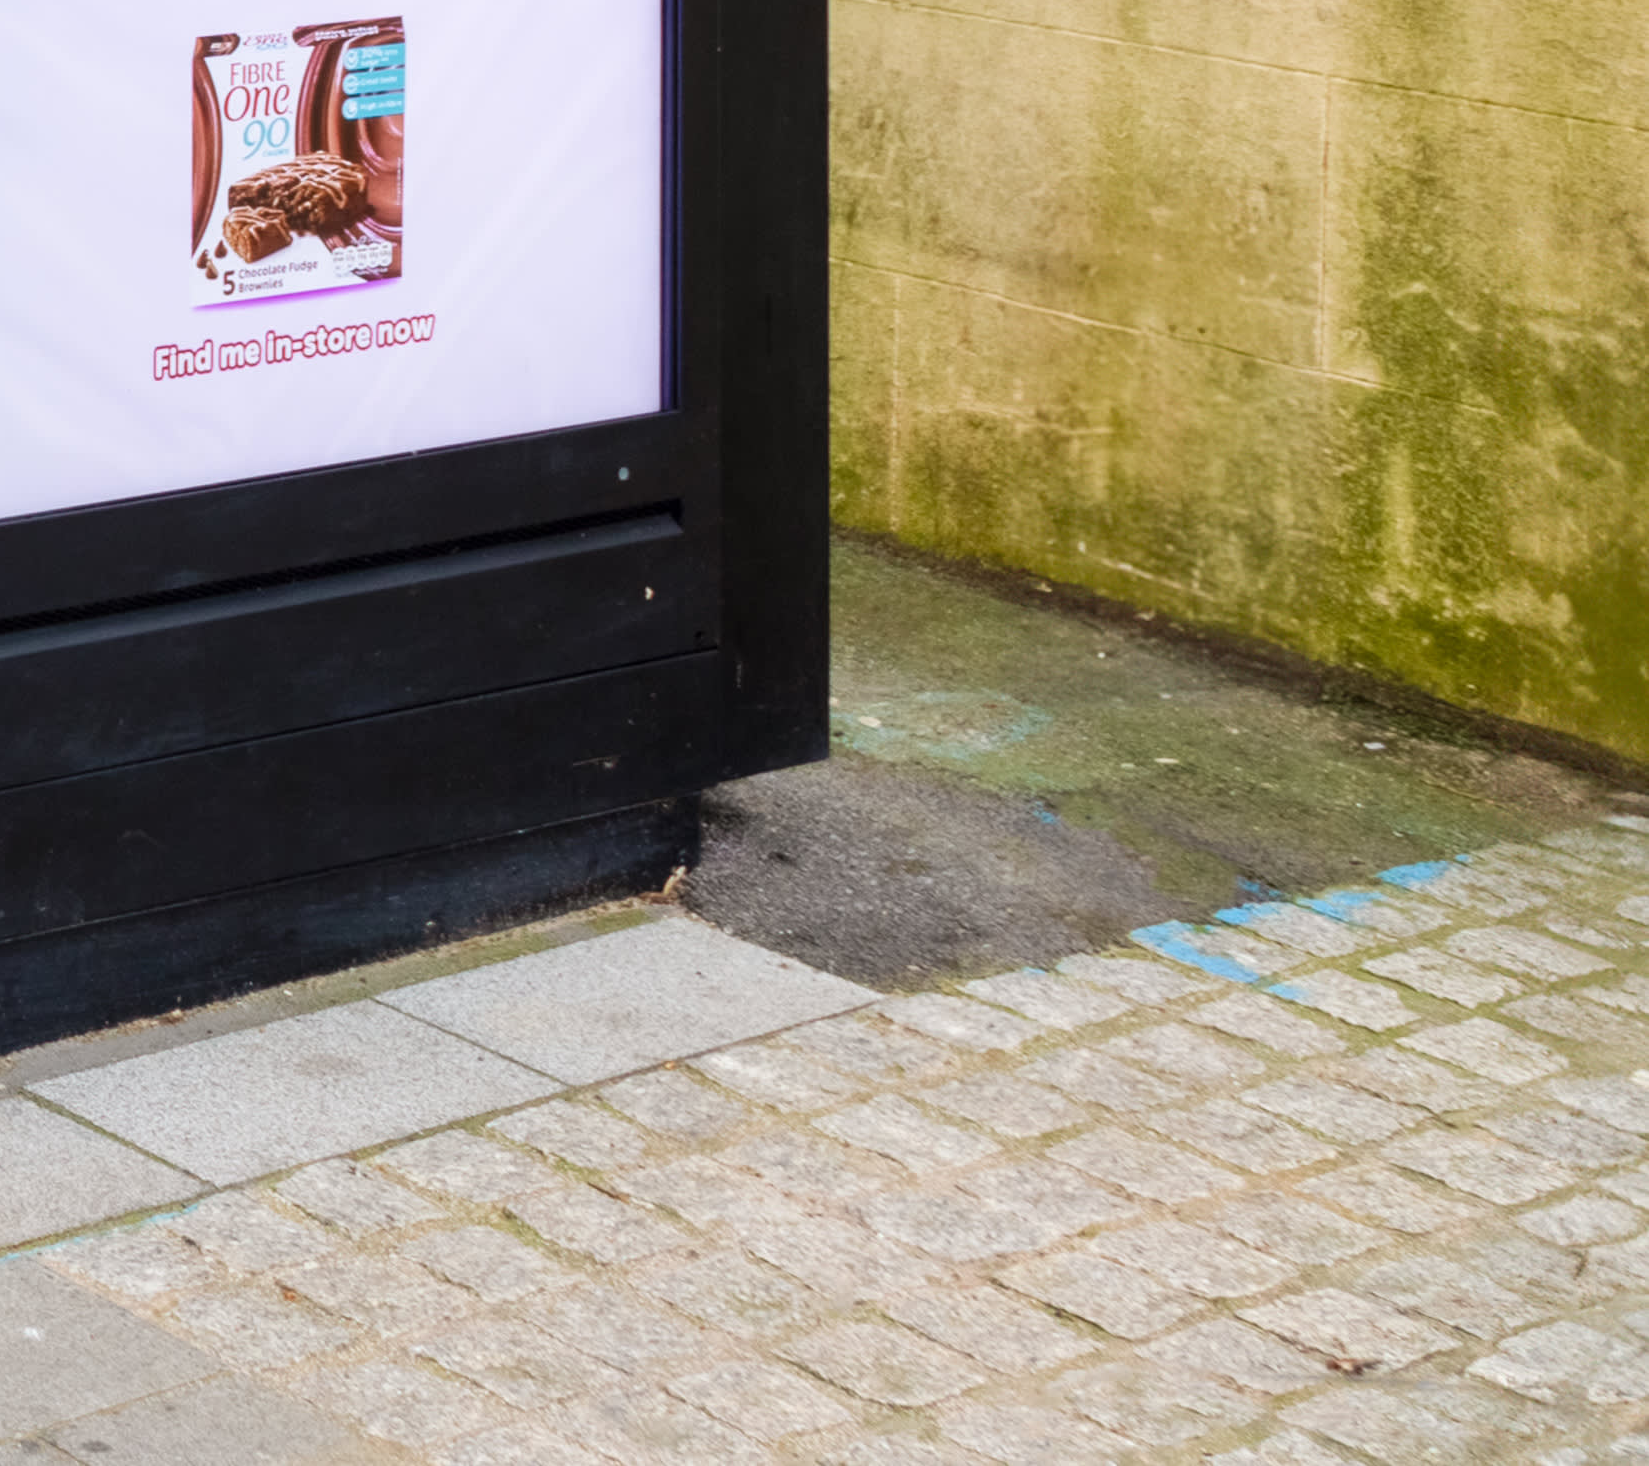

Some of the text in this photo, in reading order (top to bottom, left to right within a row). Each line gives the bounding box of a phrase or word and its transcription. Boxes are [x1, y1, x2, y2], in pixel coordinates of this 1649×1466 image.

[230, 61, 286, 86] FIBRE
[224, 84, 290, 122] One
[243, 117, 290, 161] 90
[223, 270, 235, 296] 5
[238, 260, 318, 280] Chocolate Fudge
[238, 278, 283, 293] Brownies
[153, 314, 436, 381] Find me in-store now
